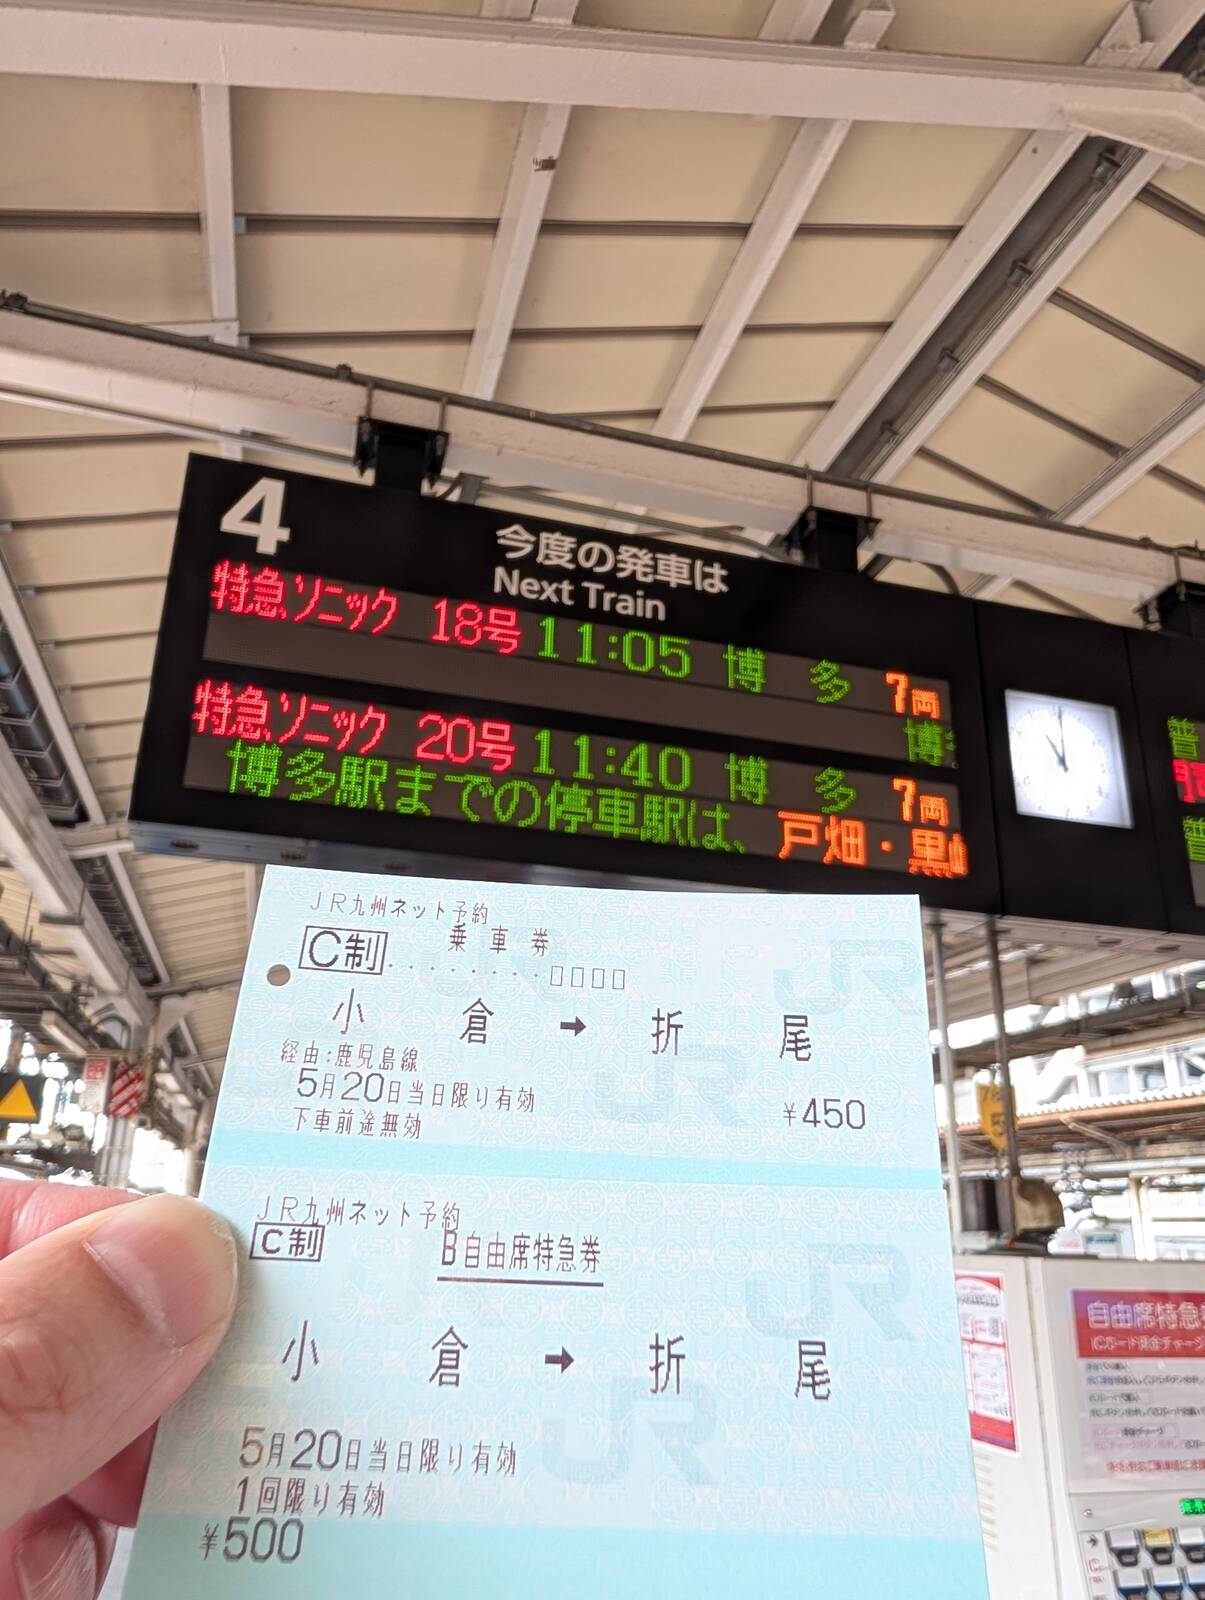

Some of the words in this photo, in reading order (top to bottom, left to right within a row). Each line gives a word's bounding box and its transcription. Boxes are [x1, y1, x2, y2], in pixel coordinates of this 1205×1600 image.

[219, 477, 291, 556] 4
[496, 523, 729, 594] 今度の発車は
[211, 559, 398, 635] 特急ソニック
[432, 598, 521, 655] 18号
[537, 616, 692, 679] 11:05
[494, 566, 575, 606] Next
[582, 581, 667, 621] Train
[192, 680, 387, 754] 特急ソニック
[416, 712, 516, 772] 20号
[532, 728, 692, 793] 11:40
[297, 1068, 537, 1114] 5月20日当日限り有効
[783, 1097, 867, 1131] ¥450
[293, 1106, 423, 1140] 下車前途無効
[1087, 1300, 1205, 1330] 自由席特急
[239, 1426, 518, 1477] 5月20日当日限り有効
[200, 1516, 305, 1566] ¥500
